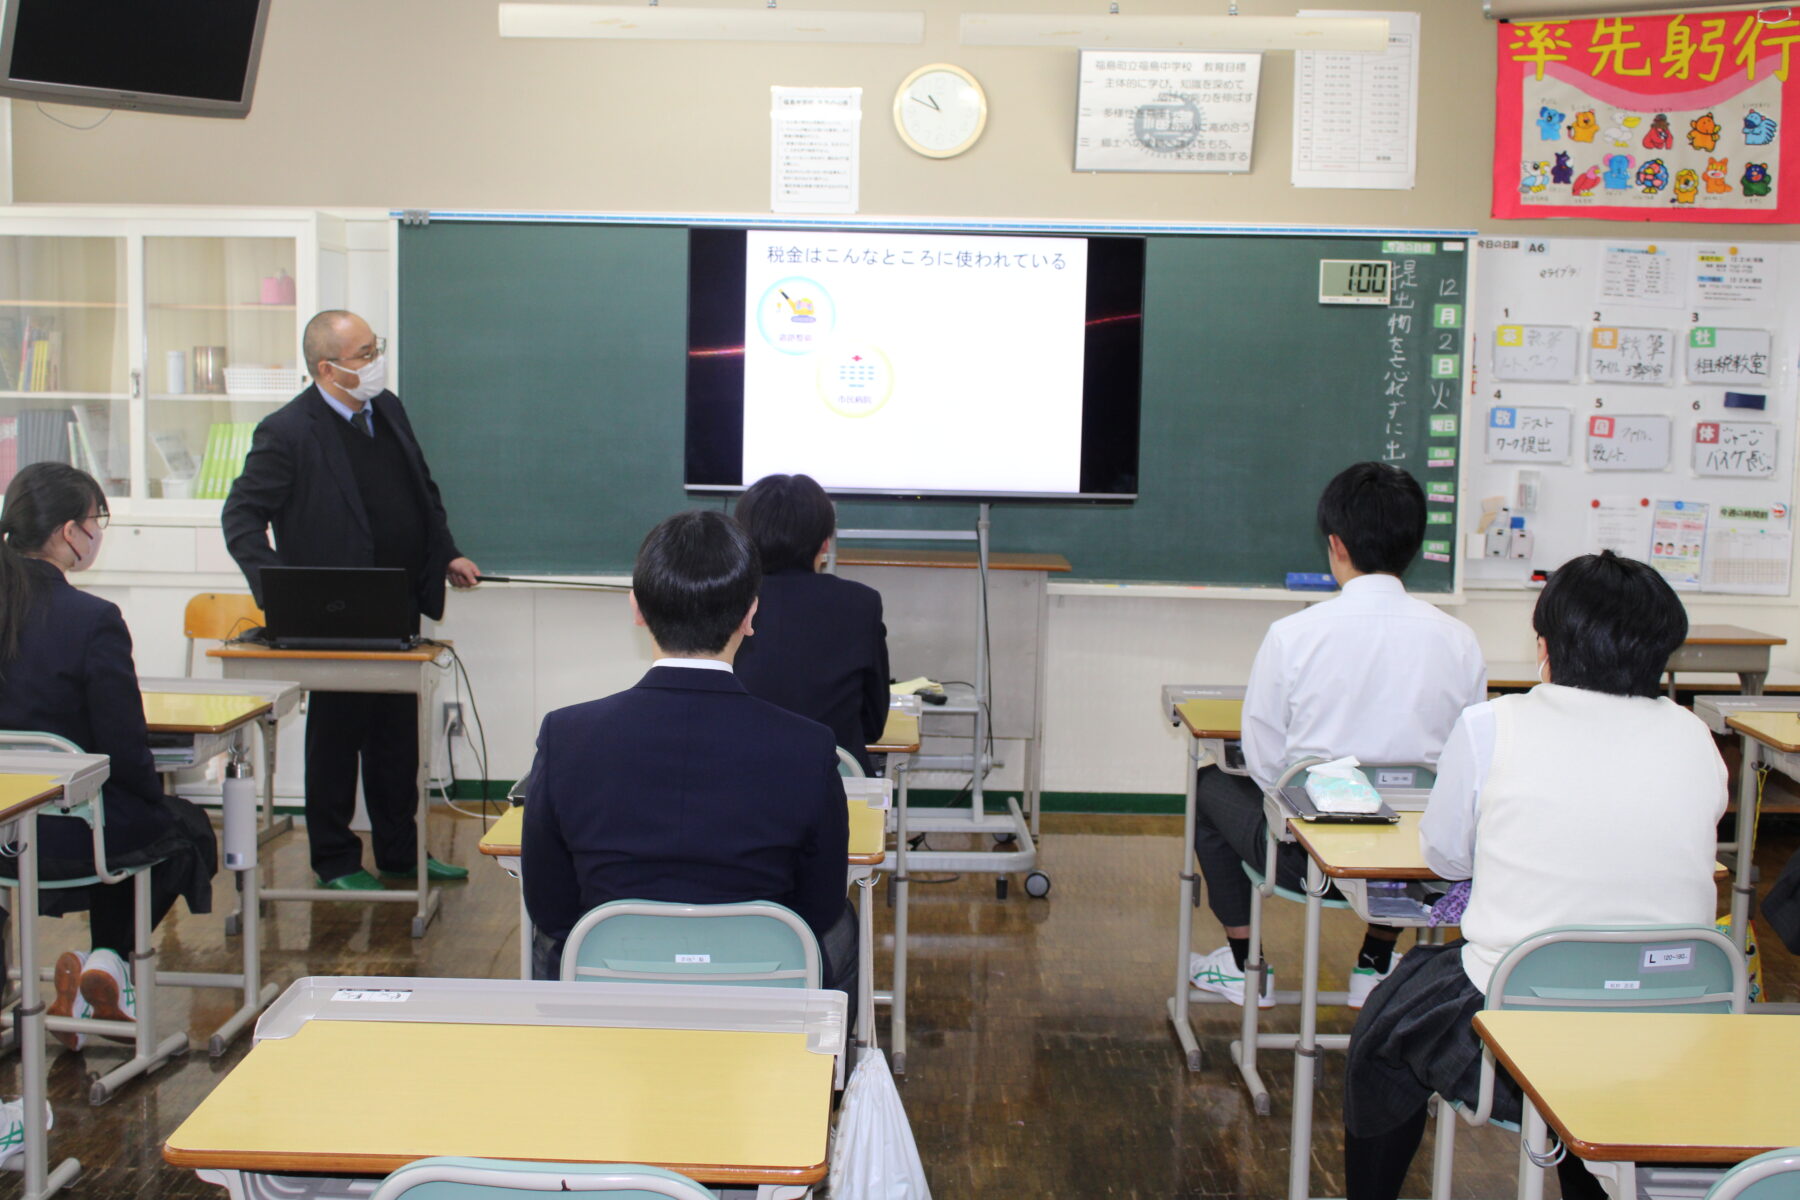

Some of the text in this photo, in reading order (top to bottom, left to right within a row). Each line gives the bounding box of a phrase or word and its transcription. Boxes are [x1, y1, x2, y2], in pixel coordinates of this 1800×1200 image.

[1096, 60, 1247, 73] 福島町立福島中学校 教育目標
[1528, 243, 1545, 254] A6
[766, 244, 1067, 271] 税金はこんなところに使われている
[1593, 312, 1601, 322] 2
[1692, 312, 1699, 322] 3
[1695, 330, 1712, 346] 社
[1383, 260, 1418, 469] 提出物を忘れずに出
[1695, 353, 1767, 375] 租税教室
[1494, 390, 1502, 400] 4
[1596, 398, 1603, 409] 5
[1692, 401, 1700, 411] 6
[1521, 416, 1554, 430] テスト
[1699, 425, 1715, 441] 体
[1496, 435, 1552, 454] ワーク提出
[1382, 775, 1388, 783] L
[1649, 953, 1656, 964] L
